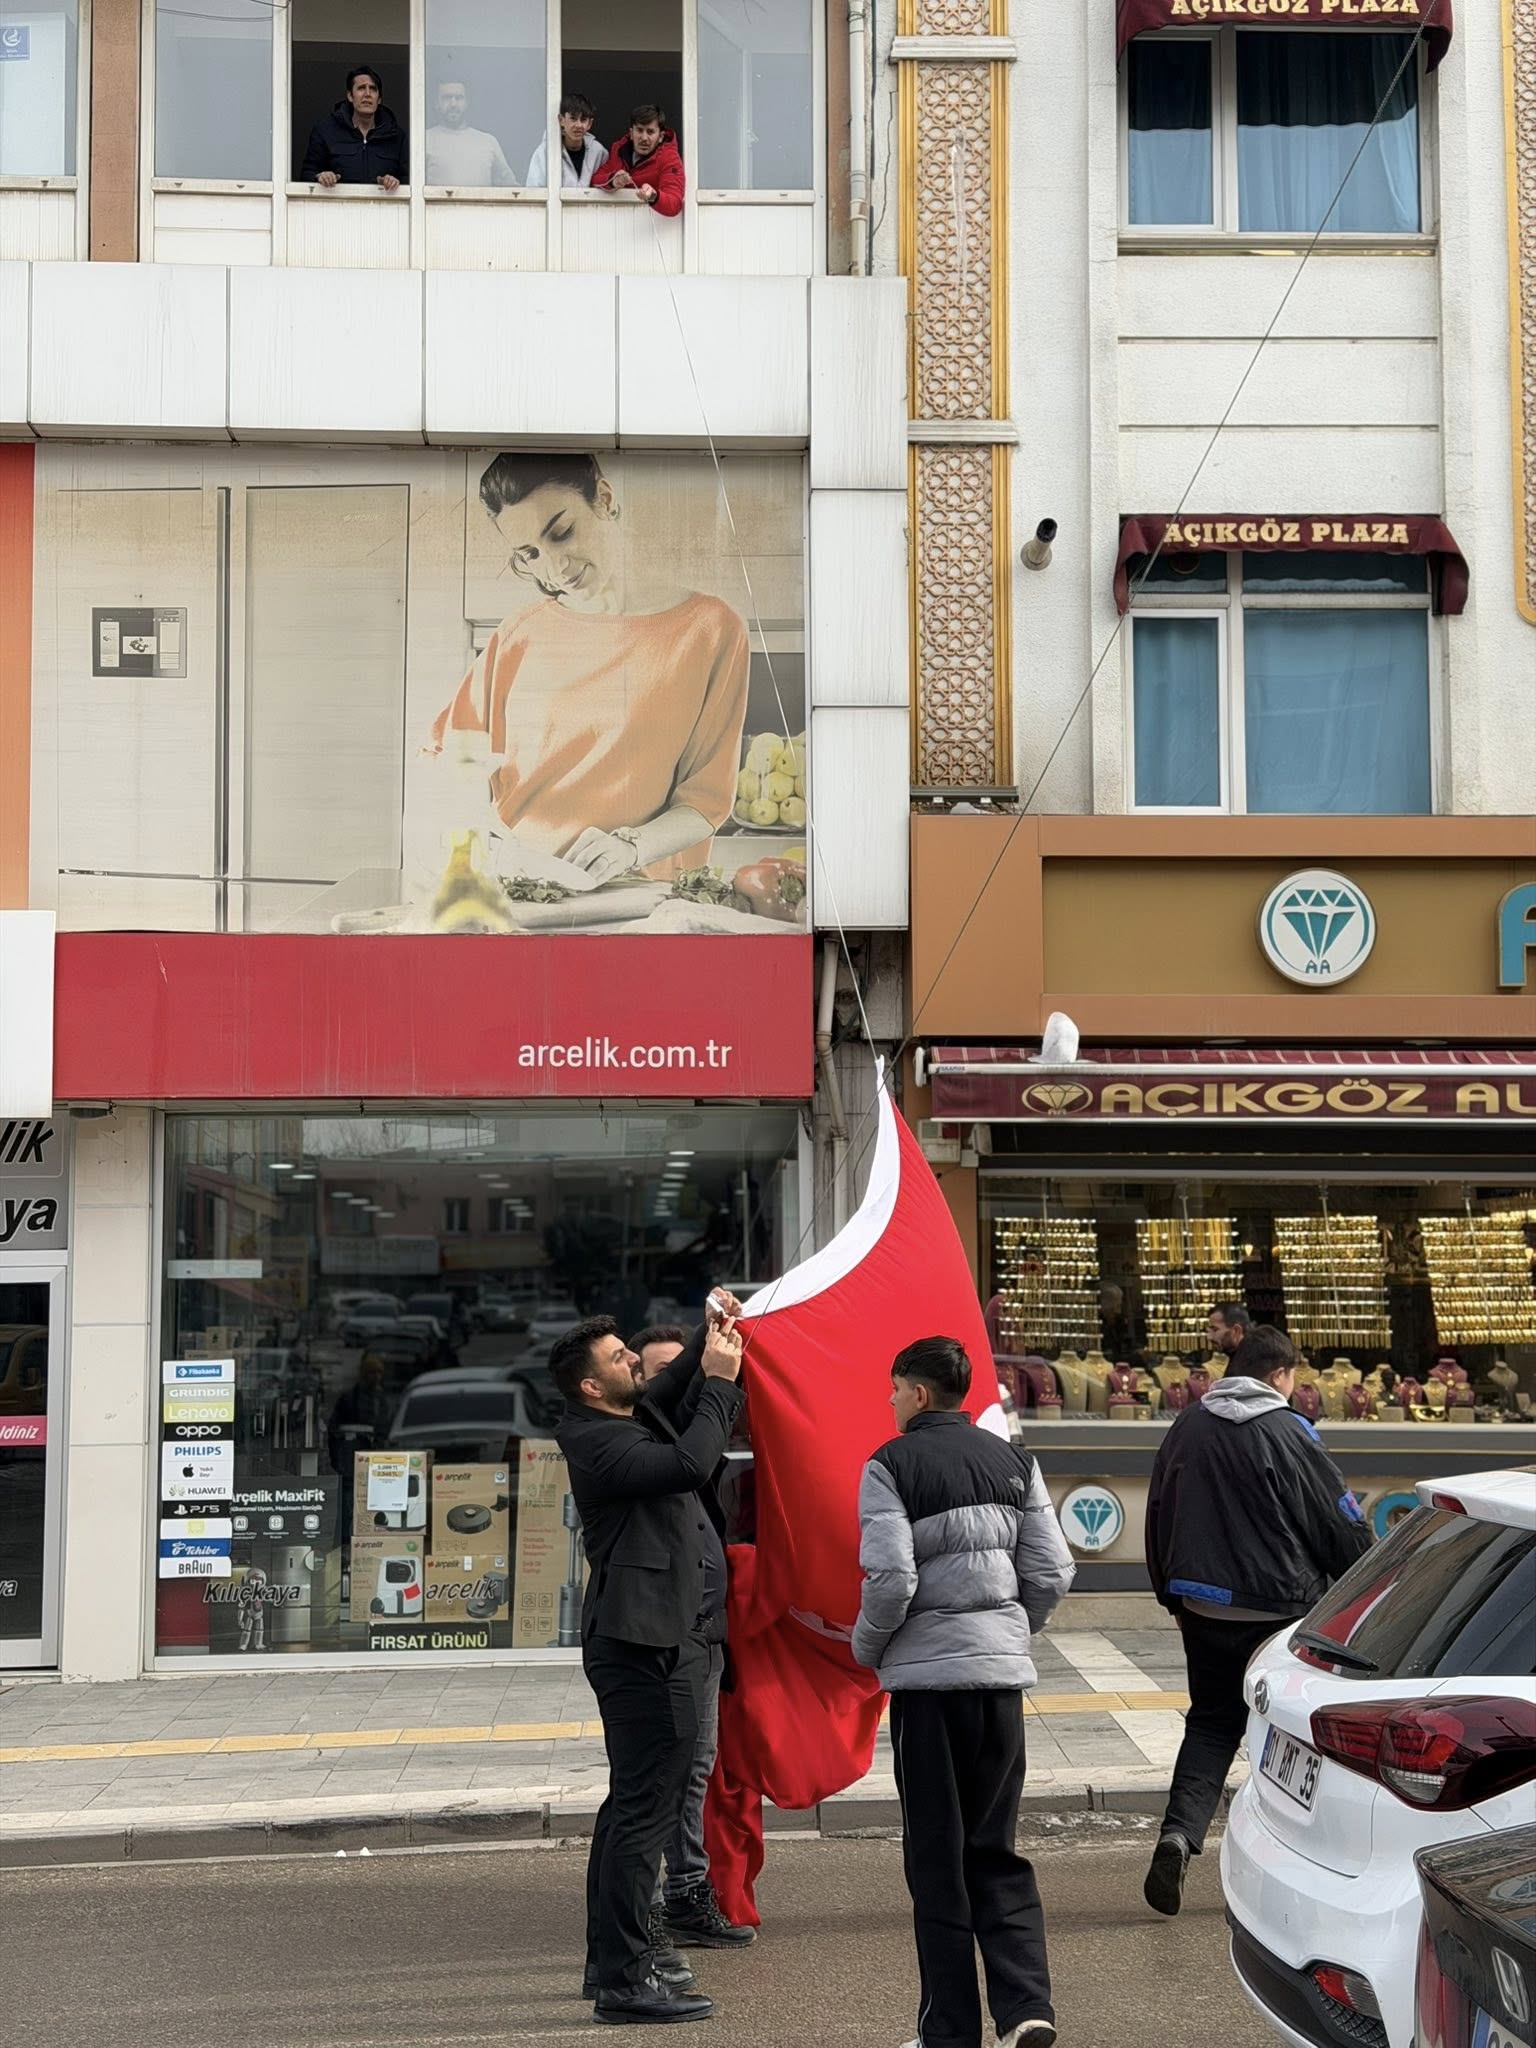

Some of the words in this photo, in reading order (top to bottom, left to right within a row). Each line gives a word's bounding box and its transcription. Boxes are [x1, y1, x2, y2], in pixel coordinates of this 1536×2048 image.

[1321, 0, 1420, 14] PLAZA
[1163, 518, 1300, 547] AÇIKGÖZ
[1311, 523, 1409, 544] PLAZA
[1305, 959, 1332, 975] AA
[518, 1036, 733, 1068] arcelik.com.tr
[1101, 1078, 1428, 1117] AÇIKGÖZ
[169, 1388, 230, 1398] GRUNDIG
[169, 1405, 229, 1419] Lenovo
[176, 1425, 221, 1438] oppo
[174, 1446, 222, 1456] PHILIPS
[188, 1487, 226, 1495] HUAWEI
[275, 1488, 326, 1503] MaxiFit
[190, 1505, 220, 1514] PS5
[185, 1546, 220, 1556] Tchibo
[178, 1560, 213, 1575] BRAUN
[203, 1583, 301, 1607] Kılıçkaya
[426, 1579, 497, 1604] arçelik
[371, 1635, 427, 1649] FIRSAT
[431, 1631, 488, 1648] ÜRÜNÜ
[1300, 1756, 1319, 1801] 35
